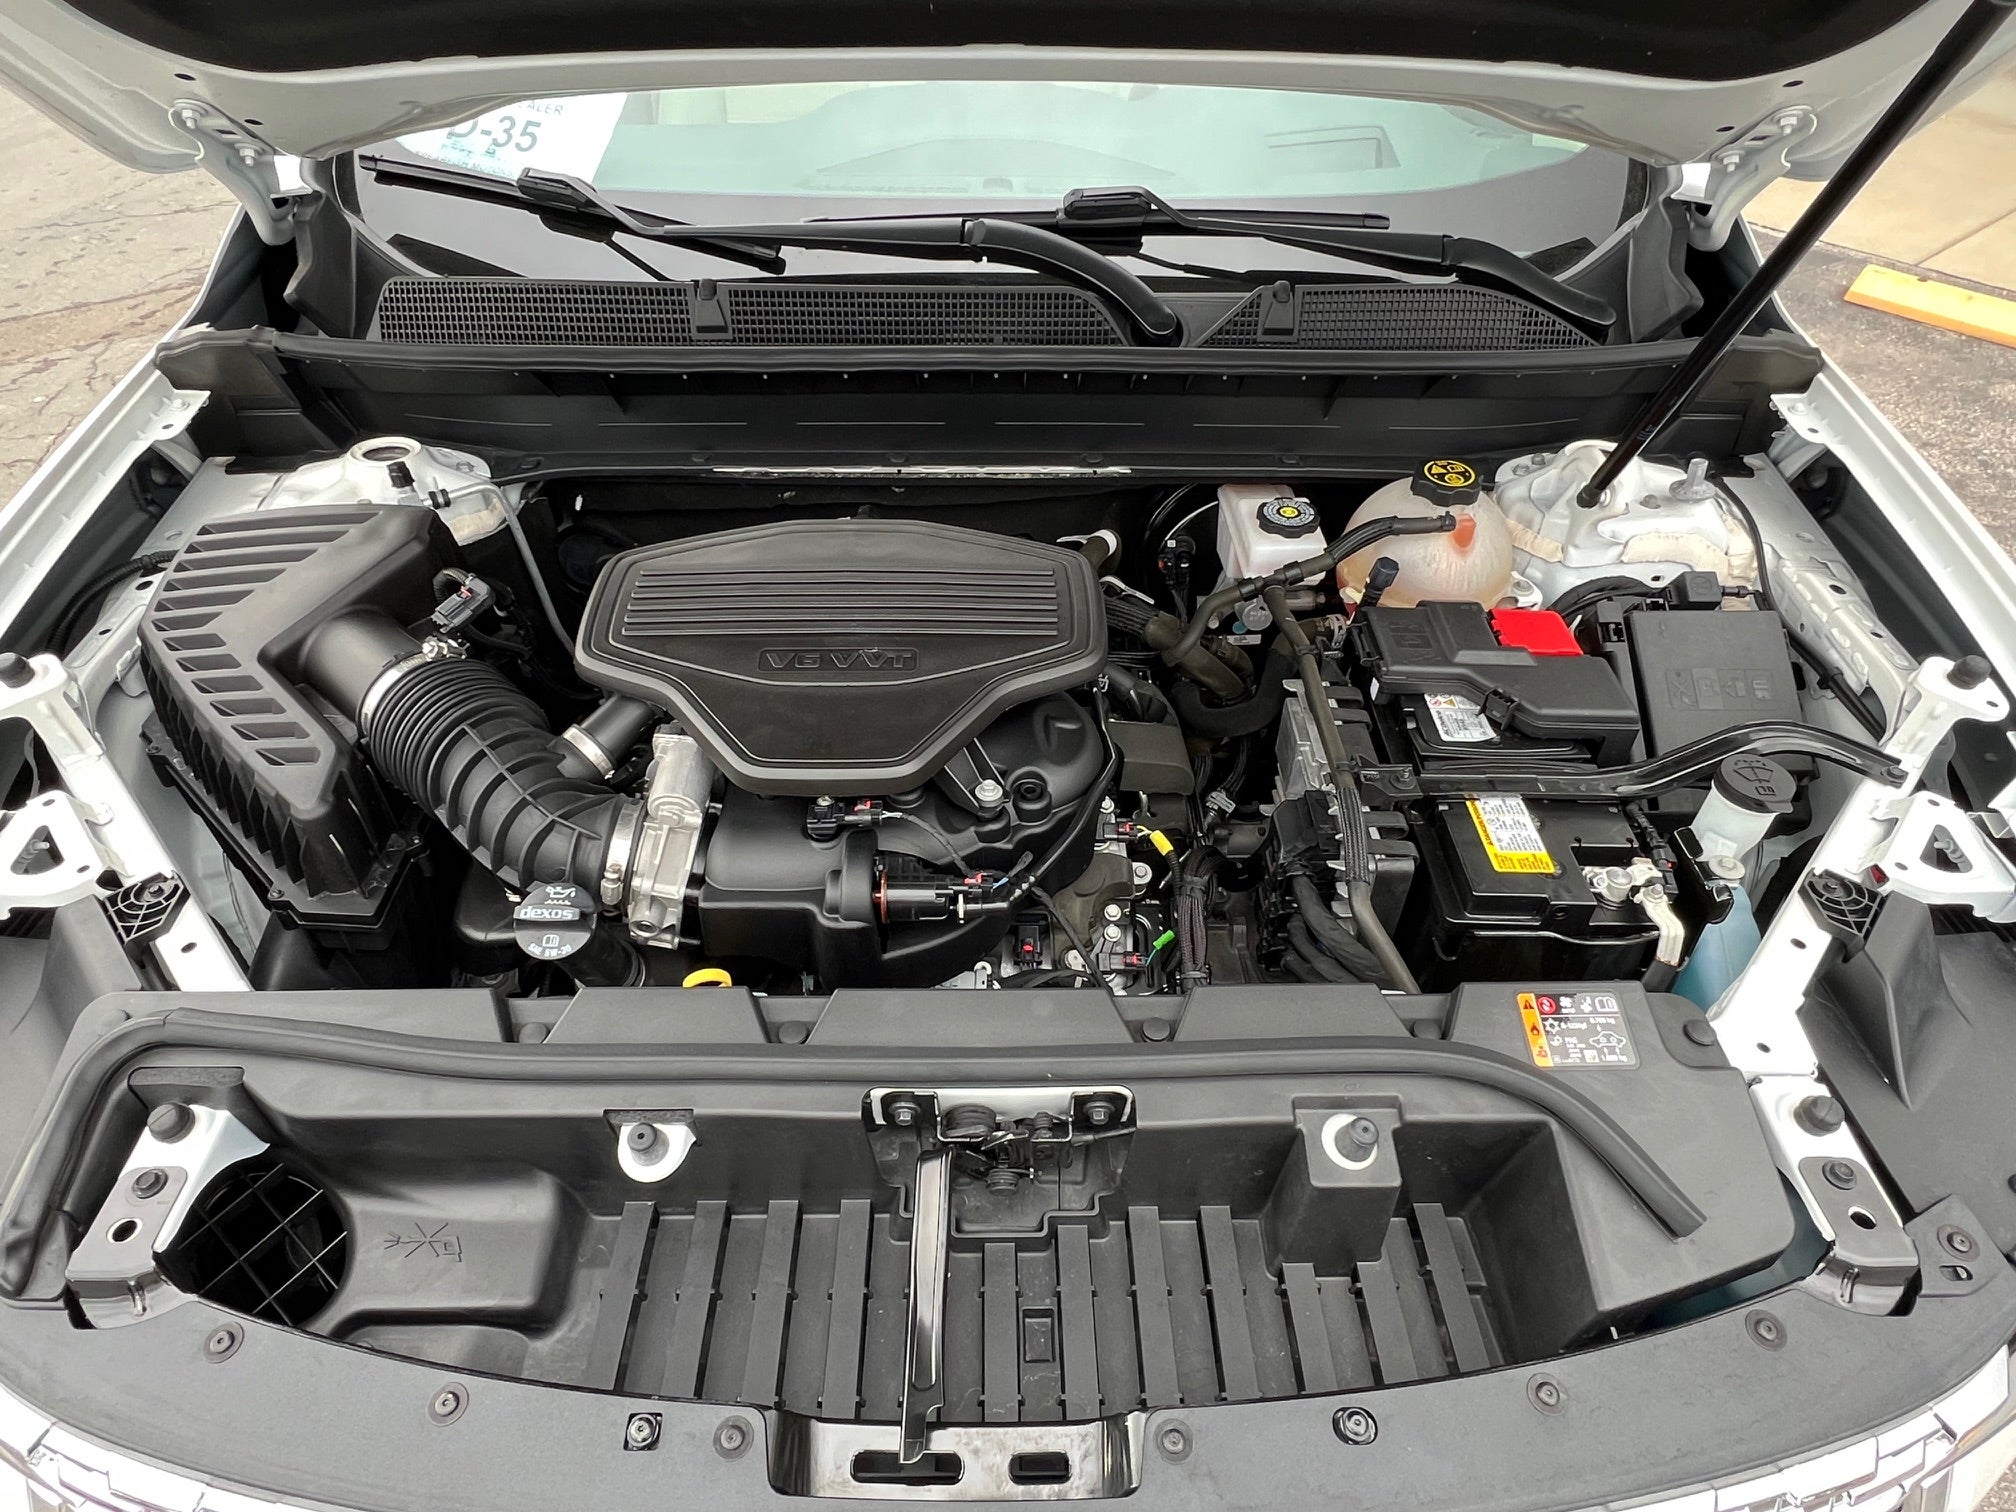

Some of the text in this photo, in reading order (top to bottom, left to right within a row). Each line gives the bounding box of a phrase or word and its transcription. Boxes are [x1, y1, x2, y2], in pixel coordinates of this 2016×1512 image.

[766, 652, 912, 668] V6 VVT
[520, 905, 573, 919] dexos
[528, 943, 572, 957] SAE 5W-30
